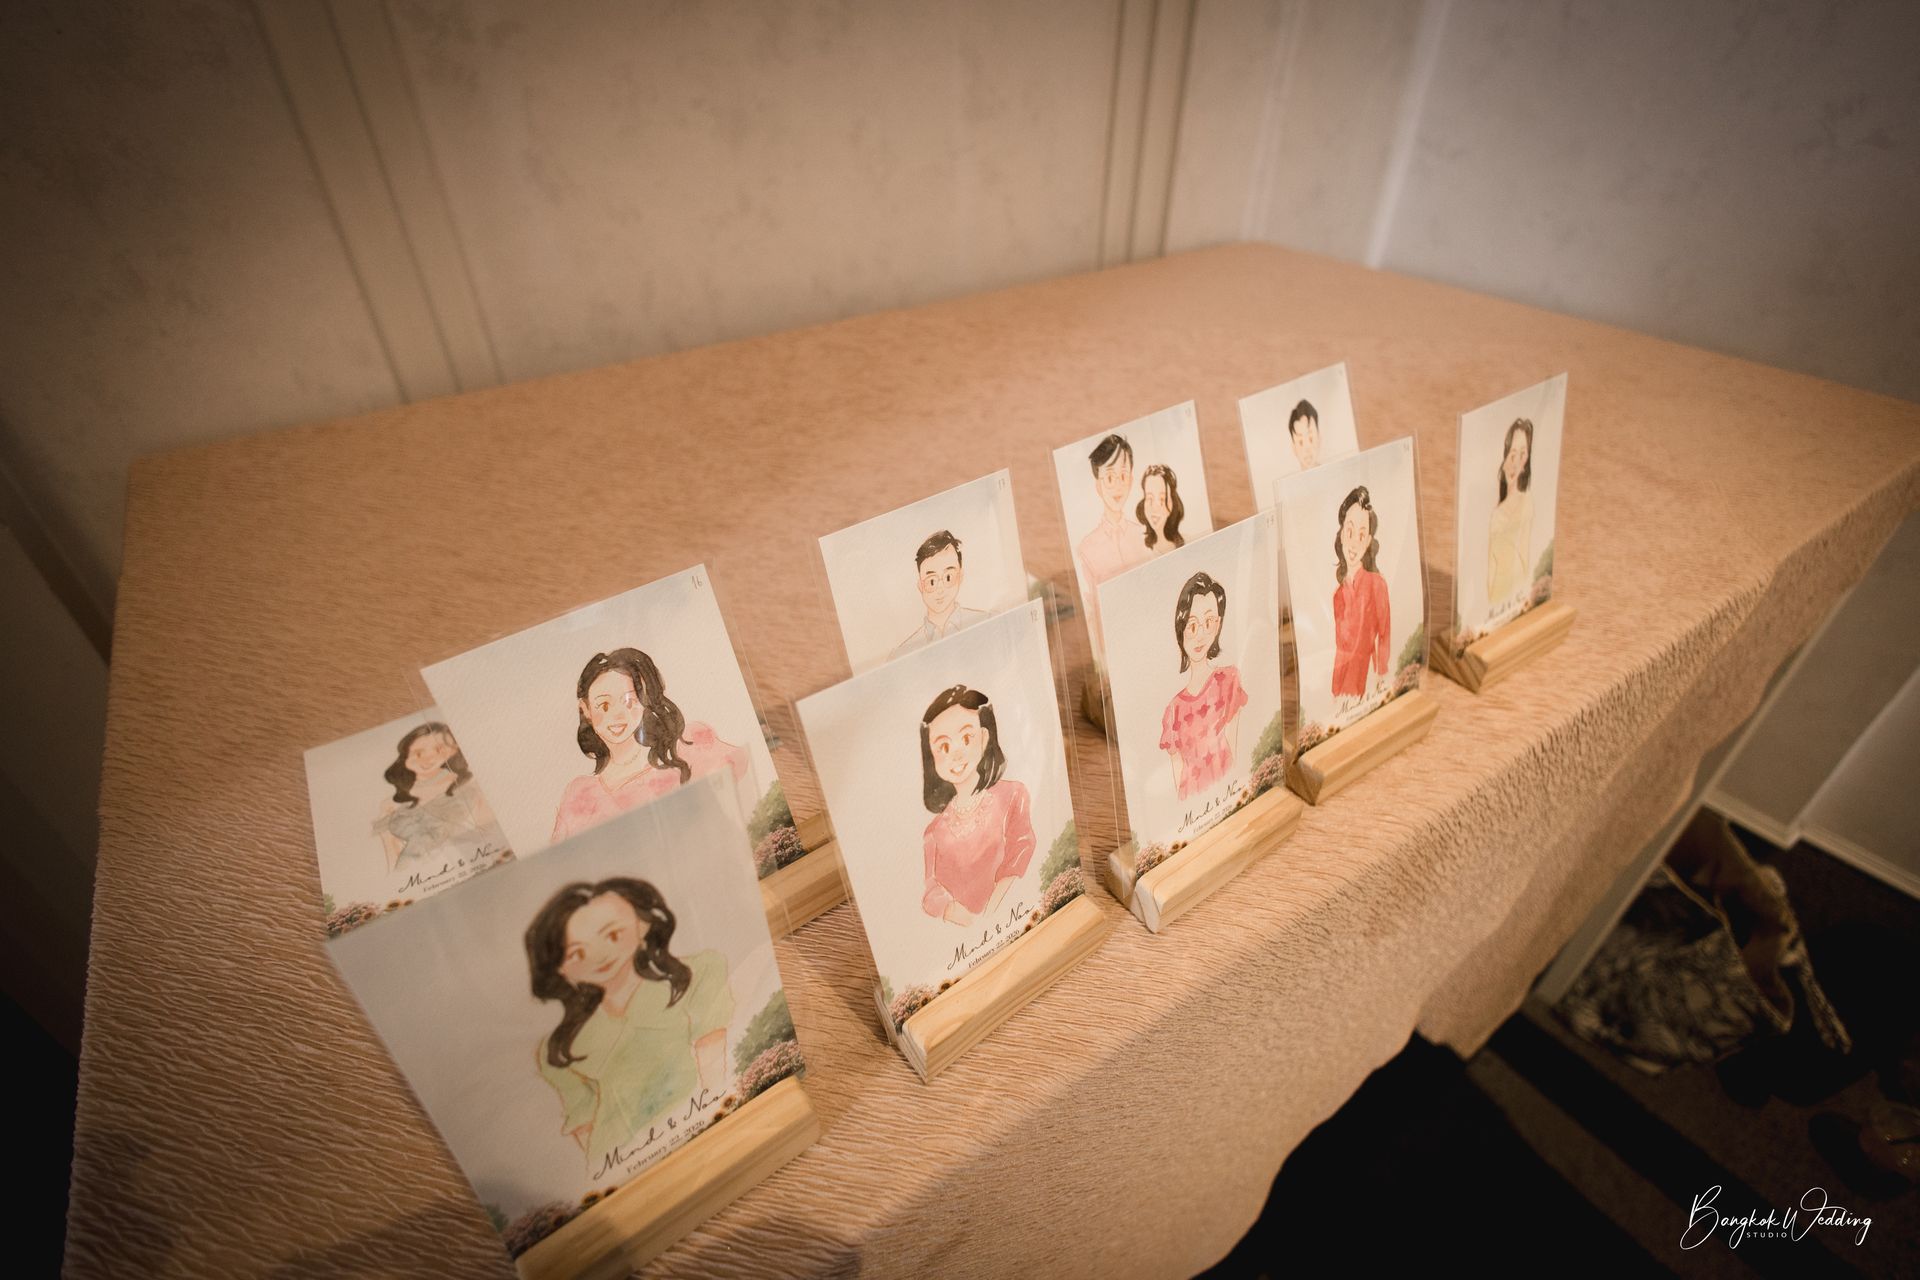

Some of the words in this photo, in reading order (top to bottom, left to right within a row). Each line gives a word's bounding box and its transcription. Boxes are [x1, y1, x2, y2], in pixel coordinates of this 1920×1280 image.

[398, 862, 455, 894] Mind
[947, 930, 993, 971] Mind
[995, 923, 1002, 935] &
[593, 1127, 665, 1181] Mind
[667, 1117, 677, 1130] &
